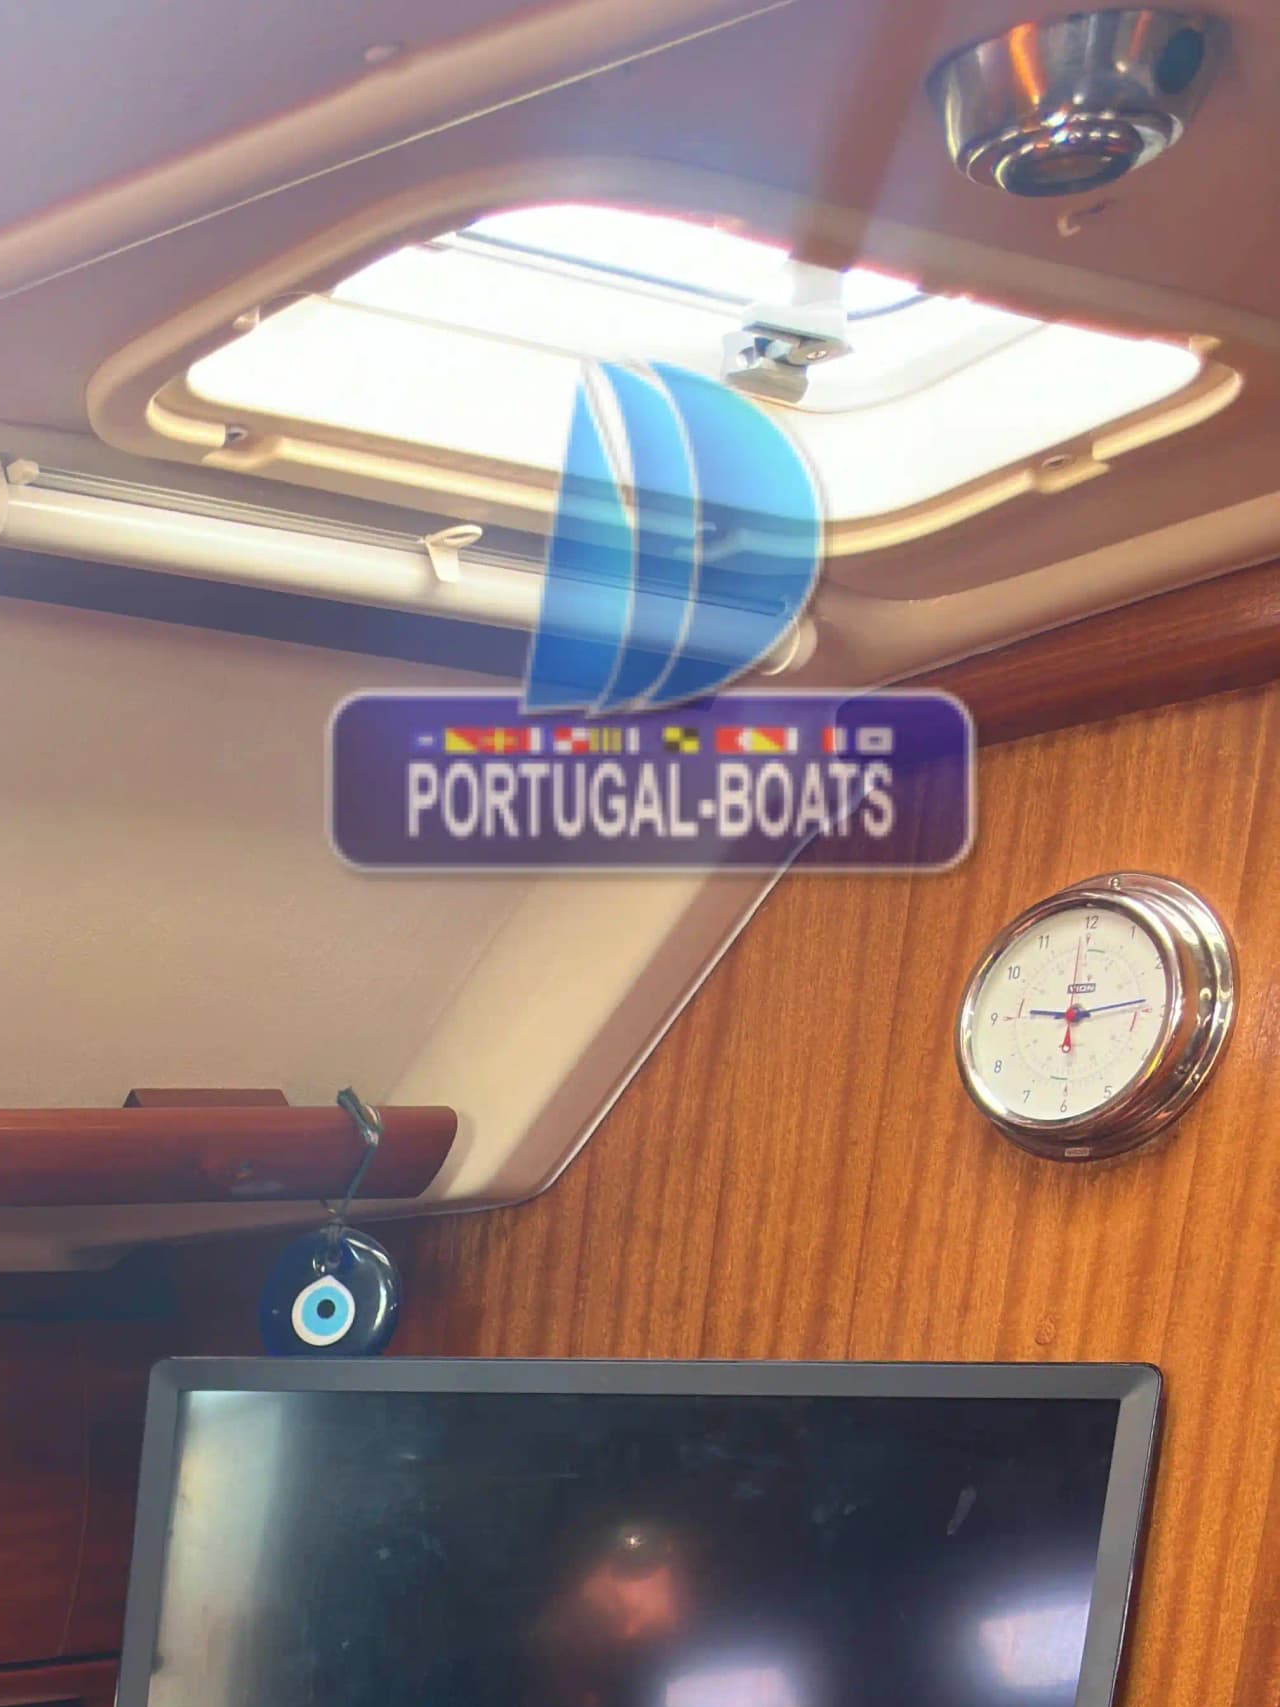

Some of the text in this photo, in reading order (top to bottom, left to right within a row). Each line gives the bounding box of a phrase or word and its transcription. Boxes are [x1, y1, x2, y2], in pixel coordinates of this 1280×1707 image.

[1085, 916, 1099, 929] 12
[1039, 935, 1050, 949] 11
[1008, 966, 1021, 980] 10
[991, 1013, 999, 1026] 9
[994, 1060, 1002, 1073] 8
[1023, 1090, 1032, 1103] 7
[1060, 1100, 1068, 1113] 6
